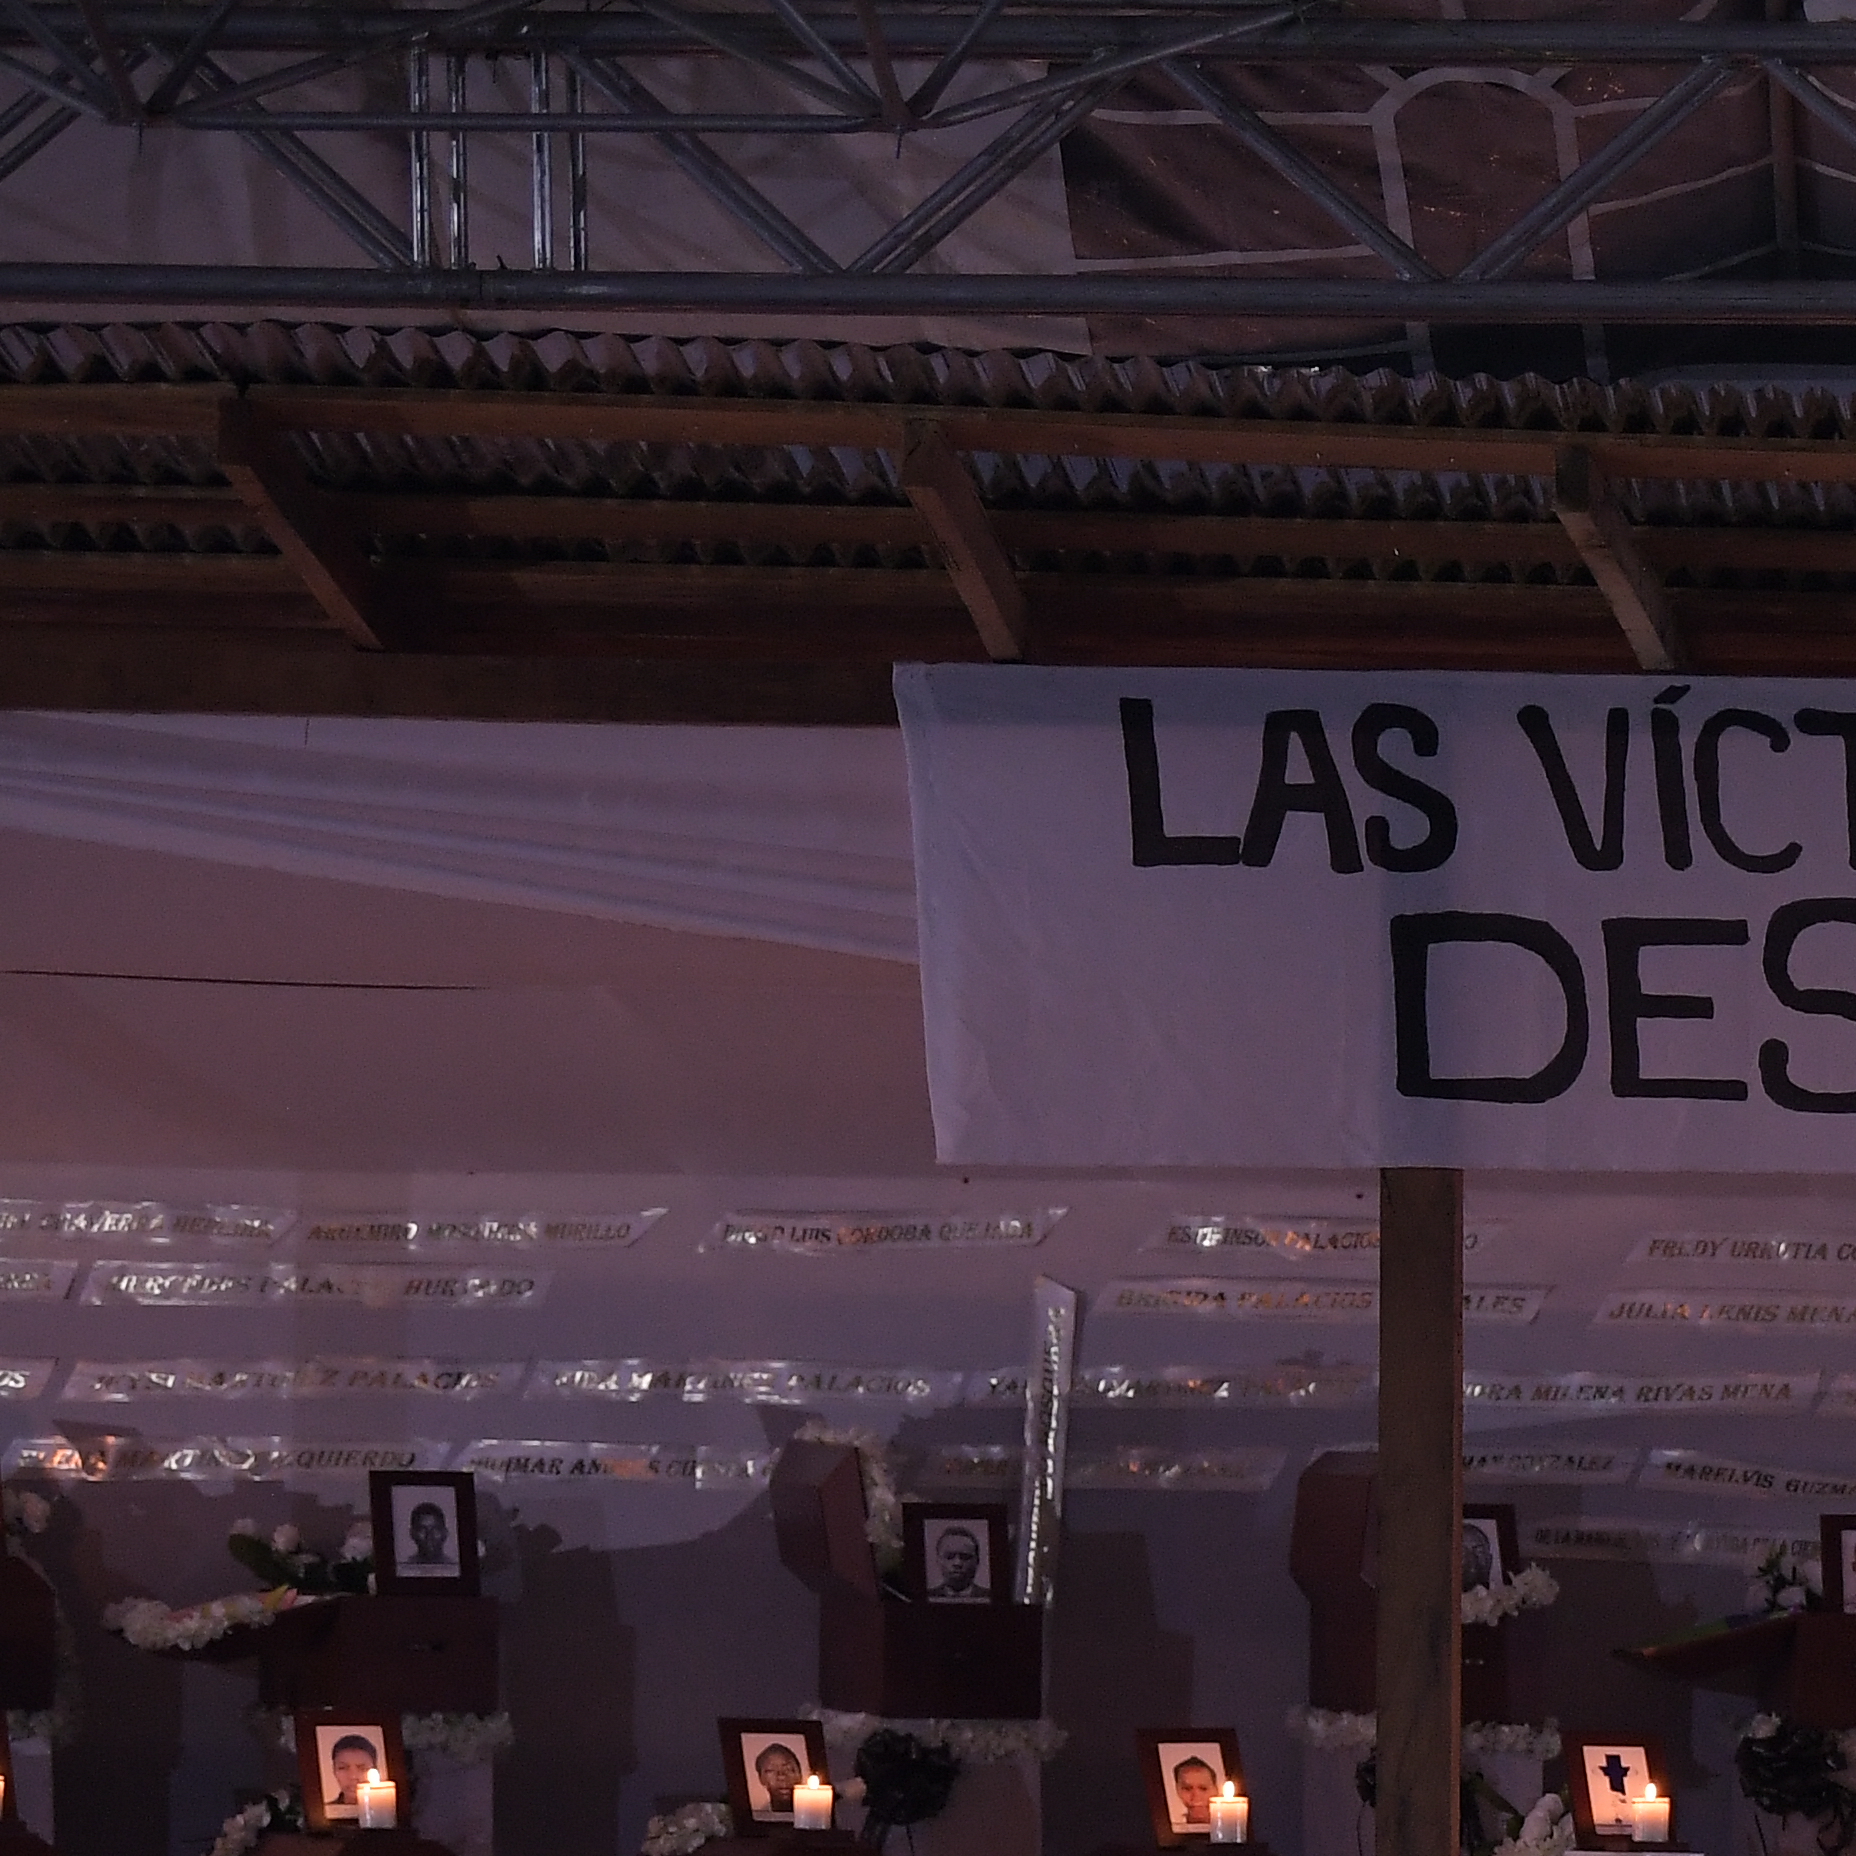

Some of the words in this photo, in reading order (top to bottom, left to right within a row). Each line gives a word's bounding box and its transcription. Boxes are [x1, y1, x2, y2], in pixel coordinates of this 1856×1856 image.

[1118, 696, 1460, 874] LAS
[788, 1226, 832, 1244] LUIS
[836, 1226, 931, 1244] CORDOBA
[1648, 1236, 1726, 1257] FREDY
[1730, 1240, 1829, 1260] URRUTIA
[1115, 1290, 1226, 1309] BRIGIDA
[1237, 1291, 1374, 1310] PALACIOS
[1609, 1301, 1692, 1321] JULIA
[1531, 1384, 1625, 1401] MILENA
[1635, 1383, 1714, 1402] RIVAS
[1721, 1382, 1792, 1401] MENA
[1664, 1461, 1775, 1489] MARELVIS
